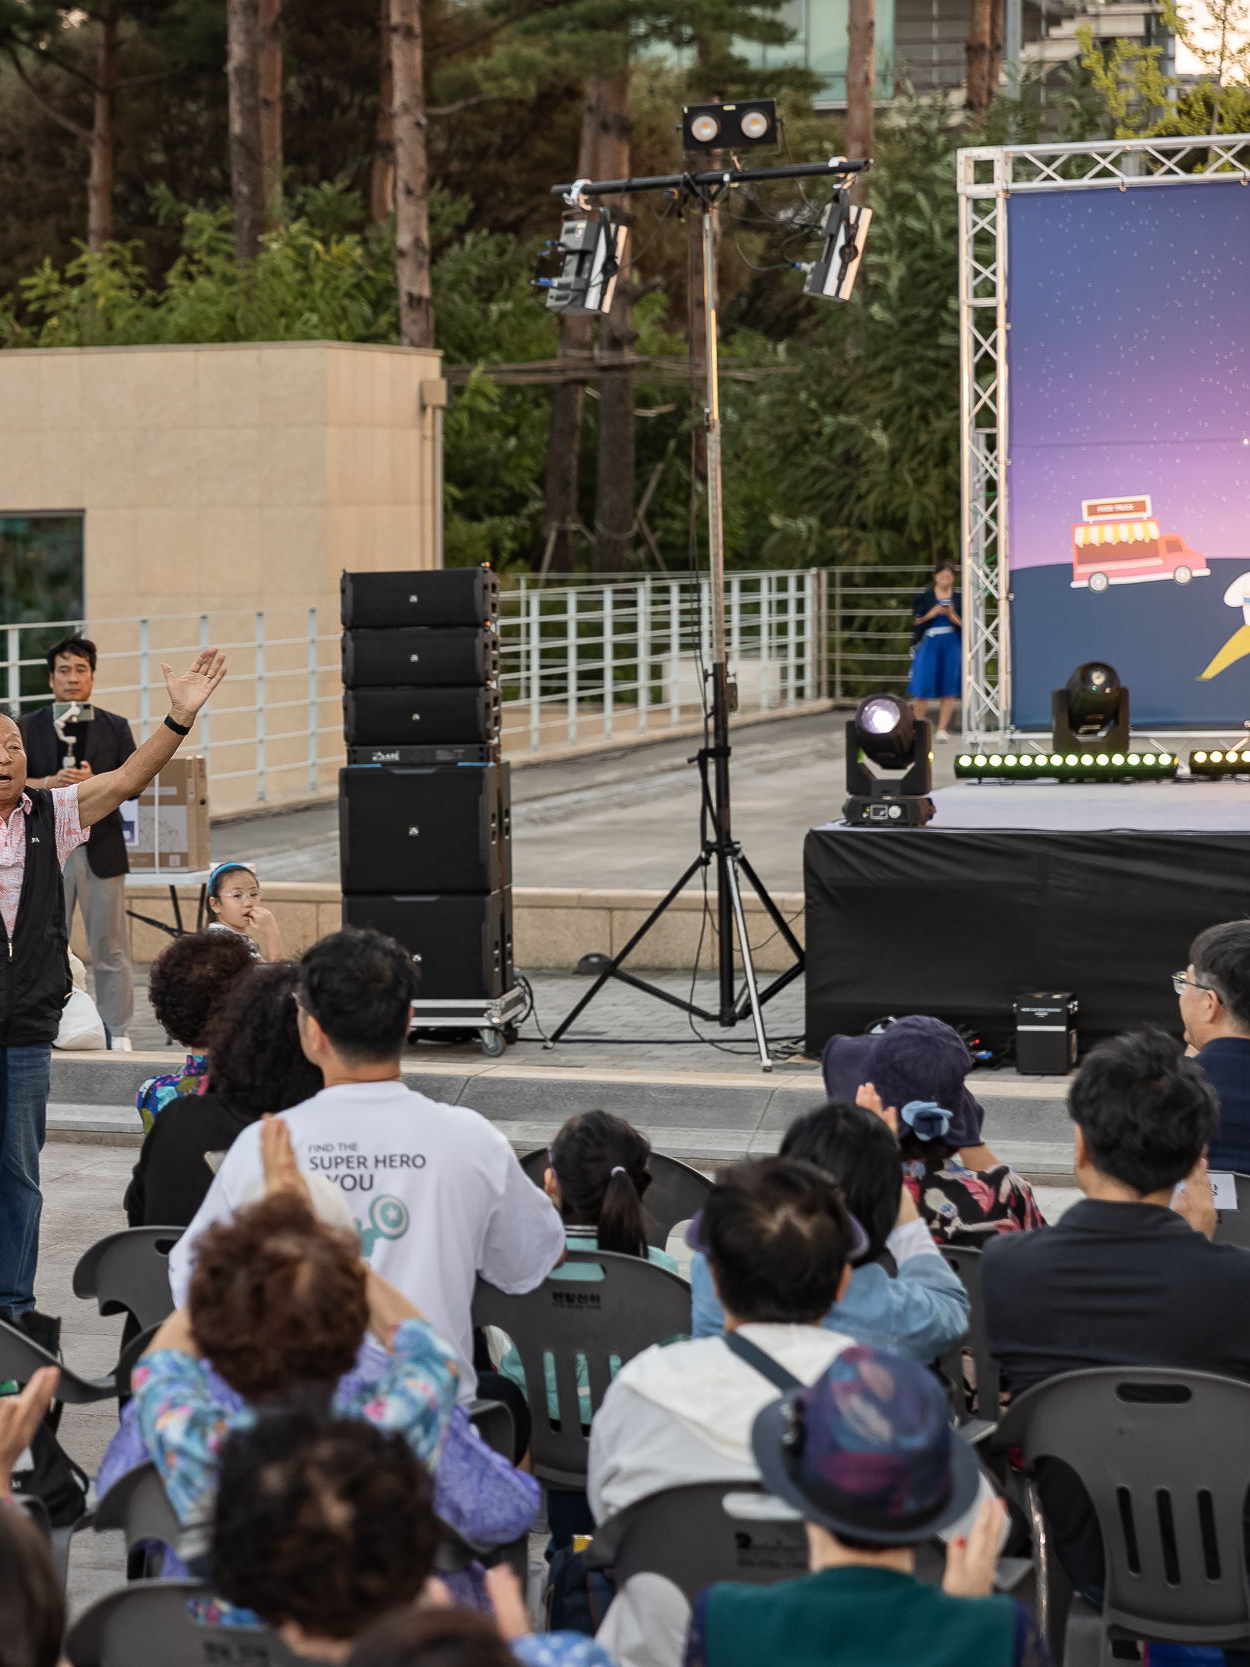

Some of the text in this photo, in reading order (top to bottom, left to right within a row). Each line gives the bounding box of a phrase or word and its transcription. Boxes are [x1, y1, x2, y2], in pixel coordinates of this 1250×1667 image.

[308, 1142, 359, 1153] FIND THE
[309, 1154, 426, 1170] SUPER HERO
